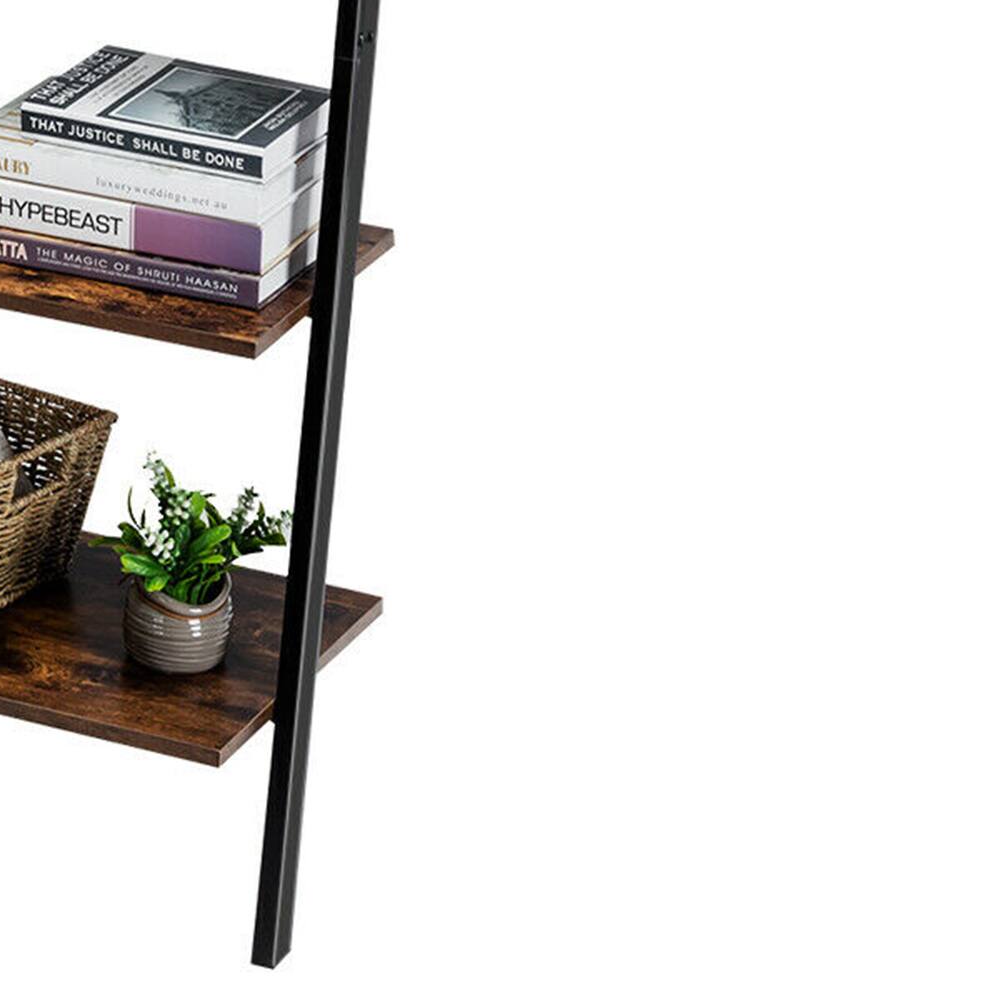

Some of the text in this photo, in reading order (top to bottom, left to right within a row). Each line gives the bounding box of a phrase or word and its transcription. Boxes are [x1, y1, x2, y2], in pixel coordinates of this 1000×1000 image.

[29, 116, 245, 171] THAT JUSTICE SHALL BE DONE
[35, 246, 58, 260] THE
[63, 252, 109, 270] MAGIC
[113, 260, 131, 273] OF
[137, 265, 181, 284] SHRUTI
[185, 275, 239, 294] HAASAN
